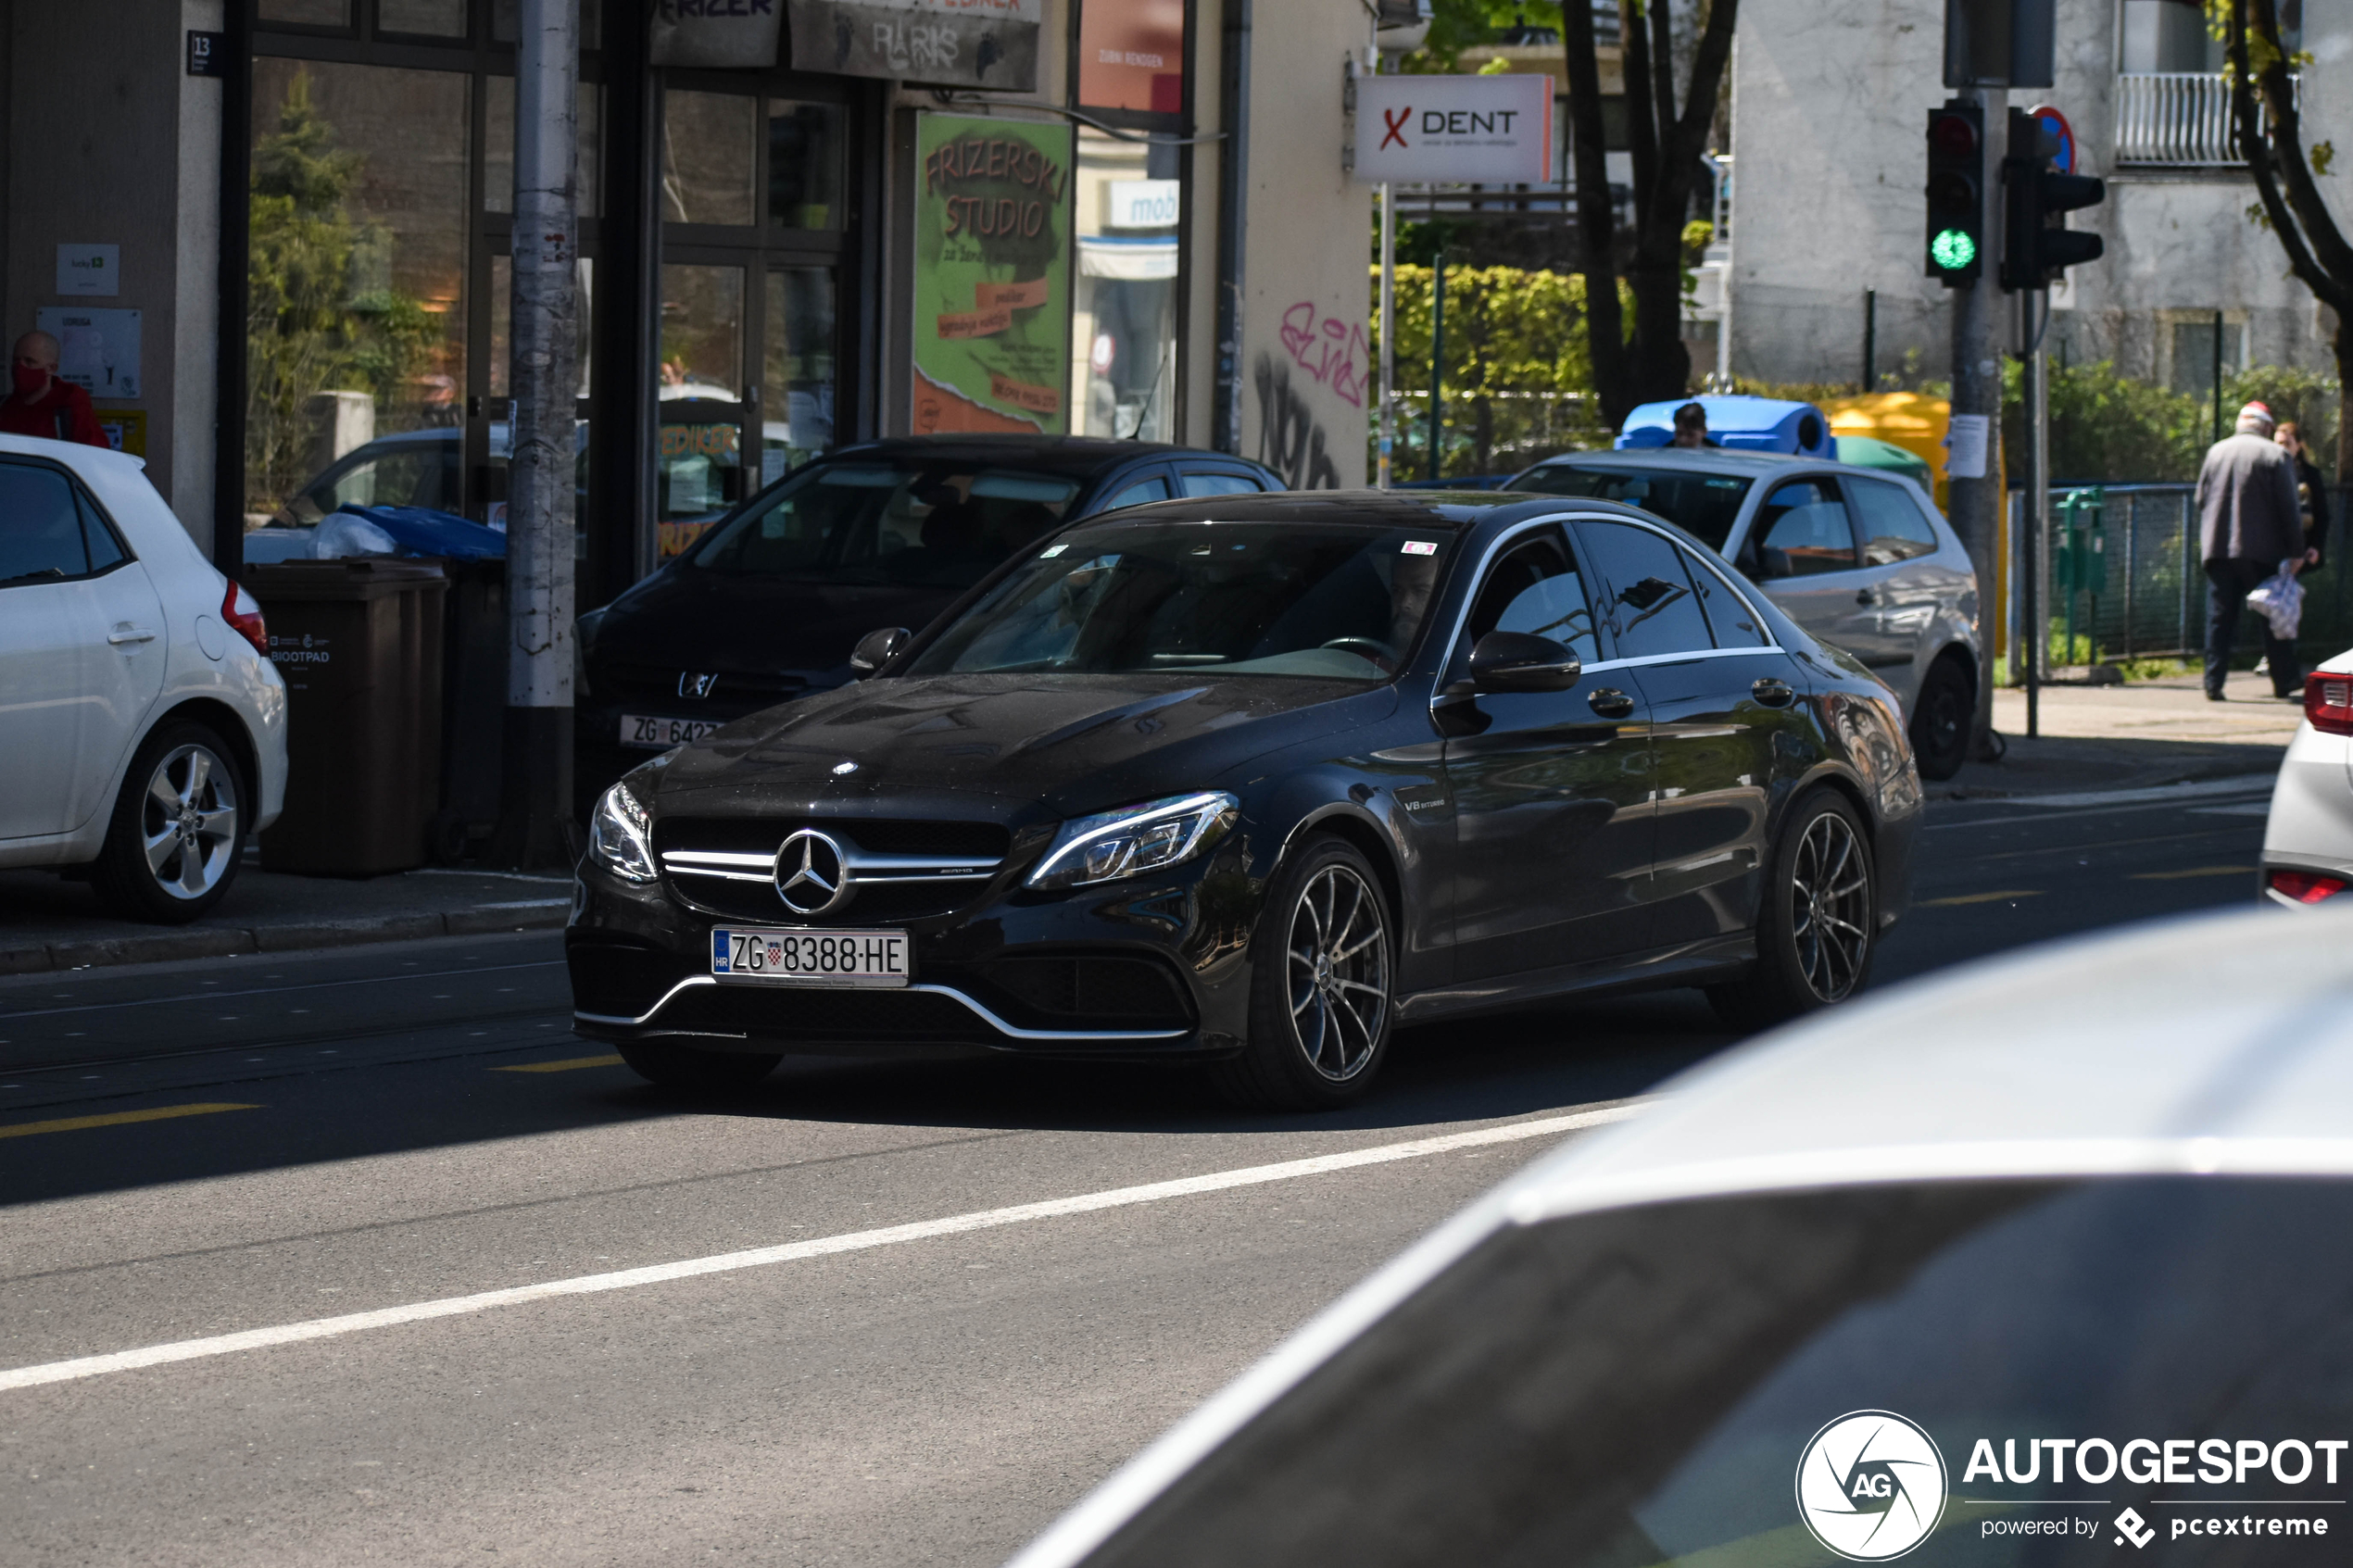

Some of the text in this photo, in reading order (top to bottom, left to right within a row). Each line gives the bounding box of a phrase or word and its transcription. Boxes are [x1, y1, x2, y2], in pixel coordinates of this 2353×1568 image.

[195, 37, 210, 56] 13
[1422, 110, 1518, 134] DENT
[925, 140, 1067, 202] FRIZERSKI
[945, 194, 1044, 237] STUDIO
[660, 426, 736, 455] EDIKER
[271, 651, 330, 662] BIOOTPAD
[635, 718, 656, 741] ZG
[1404, 801, 1420, 811] V8
[715, 957, 728, 967] HR
[732, 935, 763, 971] ZG
